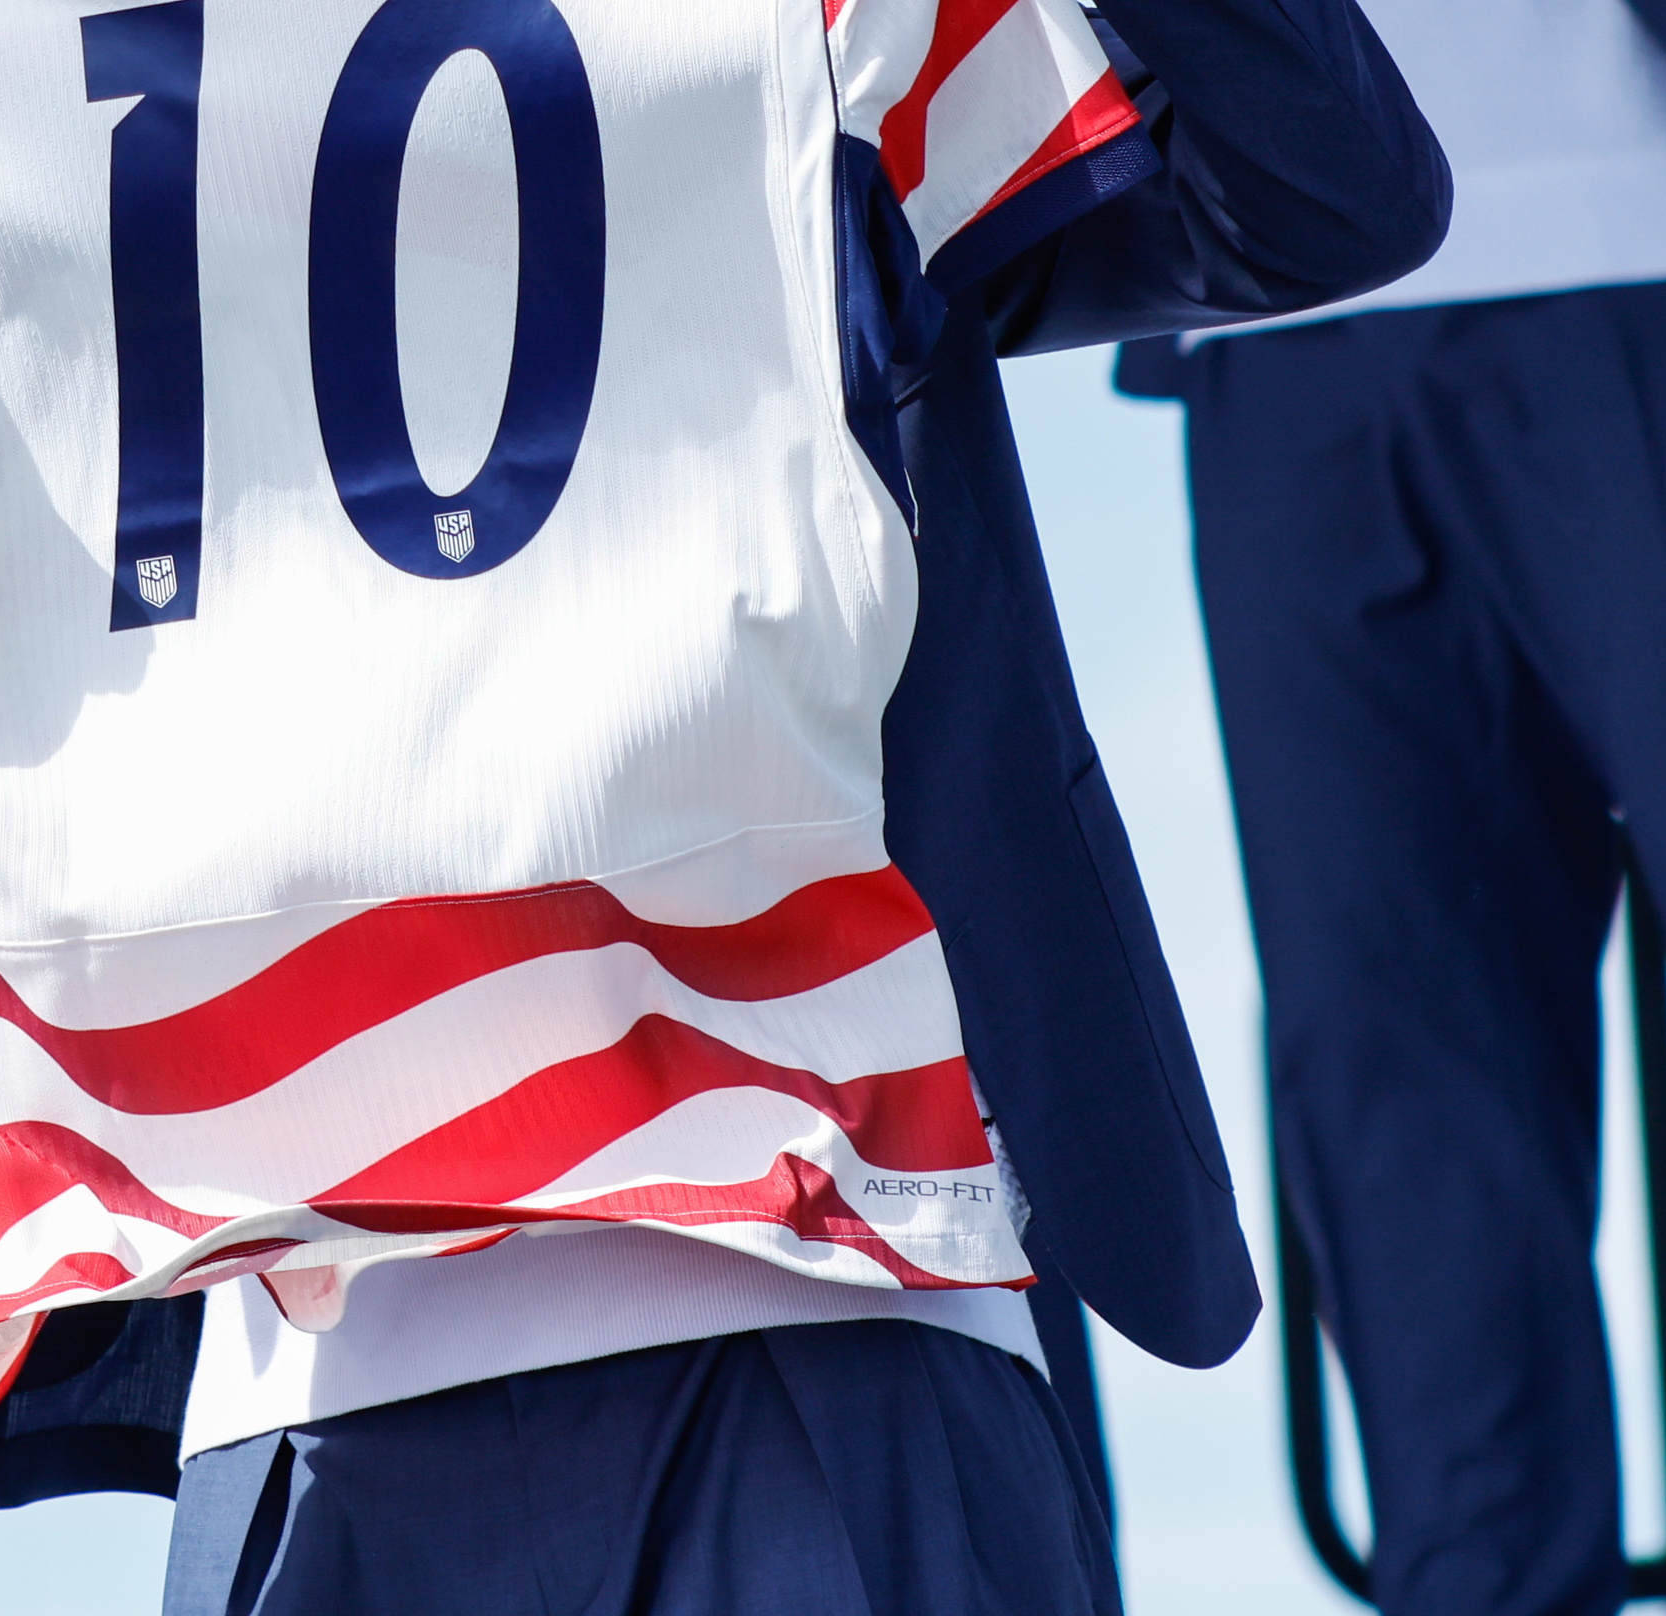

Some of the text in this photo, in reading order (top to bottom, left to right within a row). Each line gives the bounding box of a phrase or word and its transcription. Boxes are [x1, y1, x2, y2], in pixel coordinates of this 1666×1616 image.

[437, 513, 469, 535] USA
[140, 558, 172, 580] USA
[863, 1179, 995, 1203] AERO-FIT
